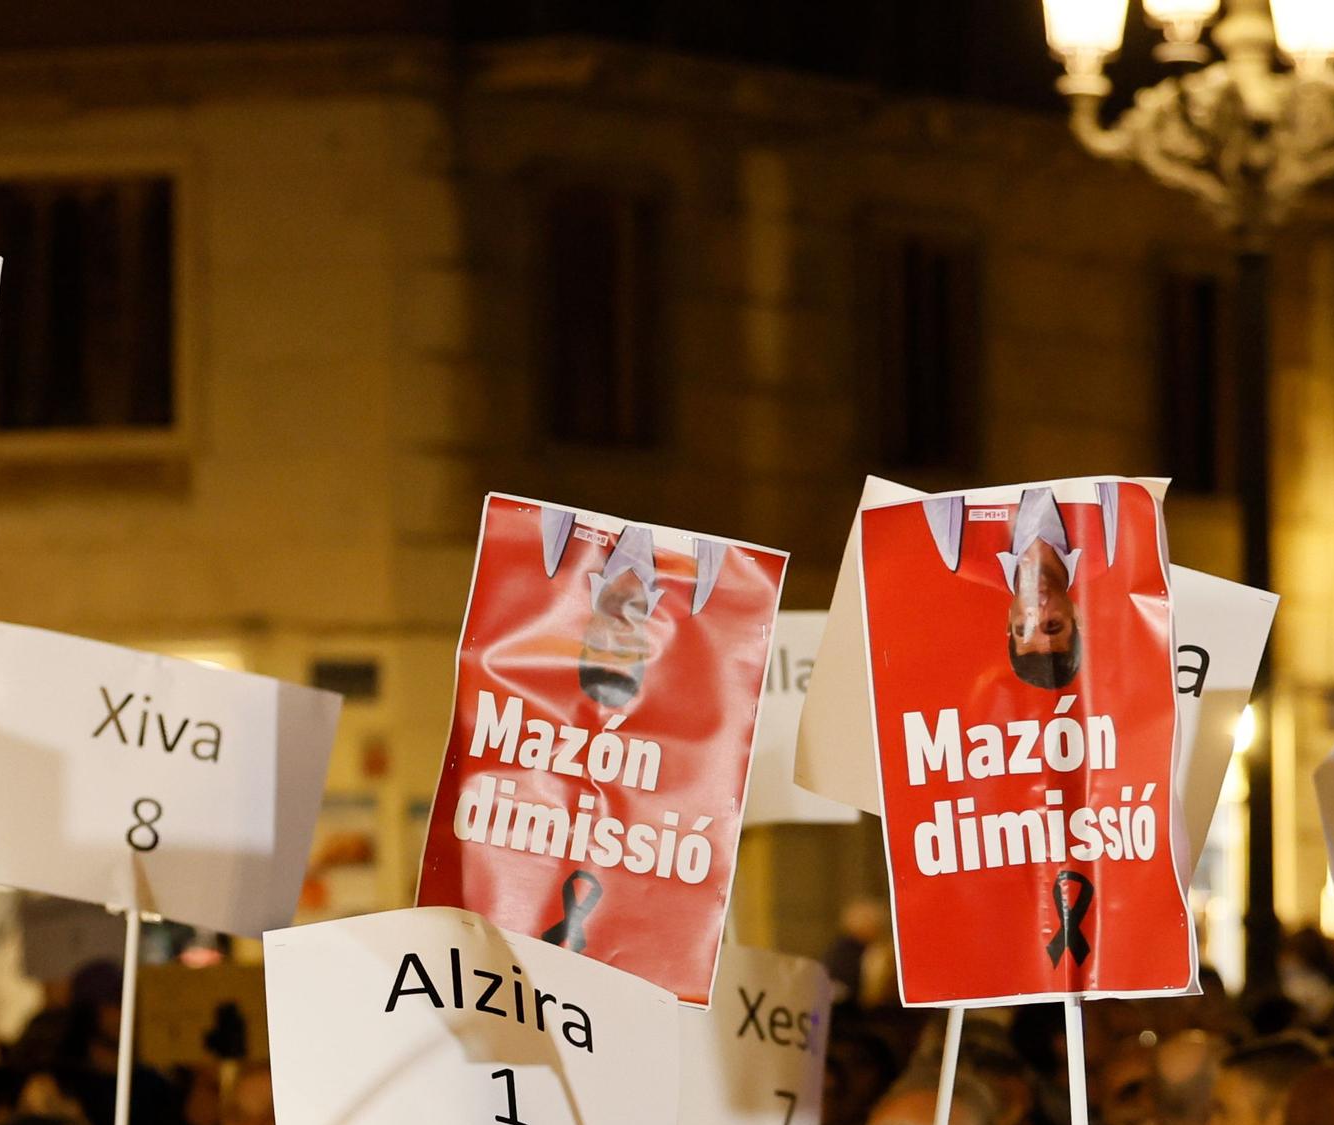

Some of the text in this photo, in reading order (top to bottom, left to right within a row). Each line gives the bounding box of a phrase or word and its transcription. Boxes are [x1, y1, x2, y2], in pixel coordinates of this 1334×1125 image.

[92, 686, 223, 762] Xiva
[469, 690, 661, 791] Mazón
[903, 695, 1116, 785] Mazón
[126, 799, 160, 852] 8
[454, 774, 712, 884] dimissió
[913, 783, 1156, 876] dimissió
[385, 948, 593, 1053] Alzira
